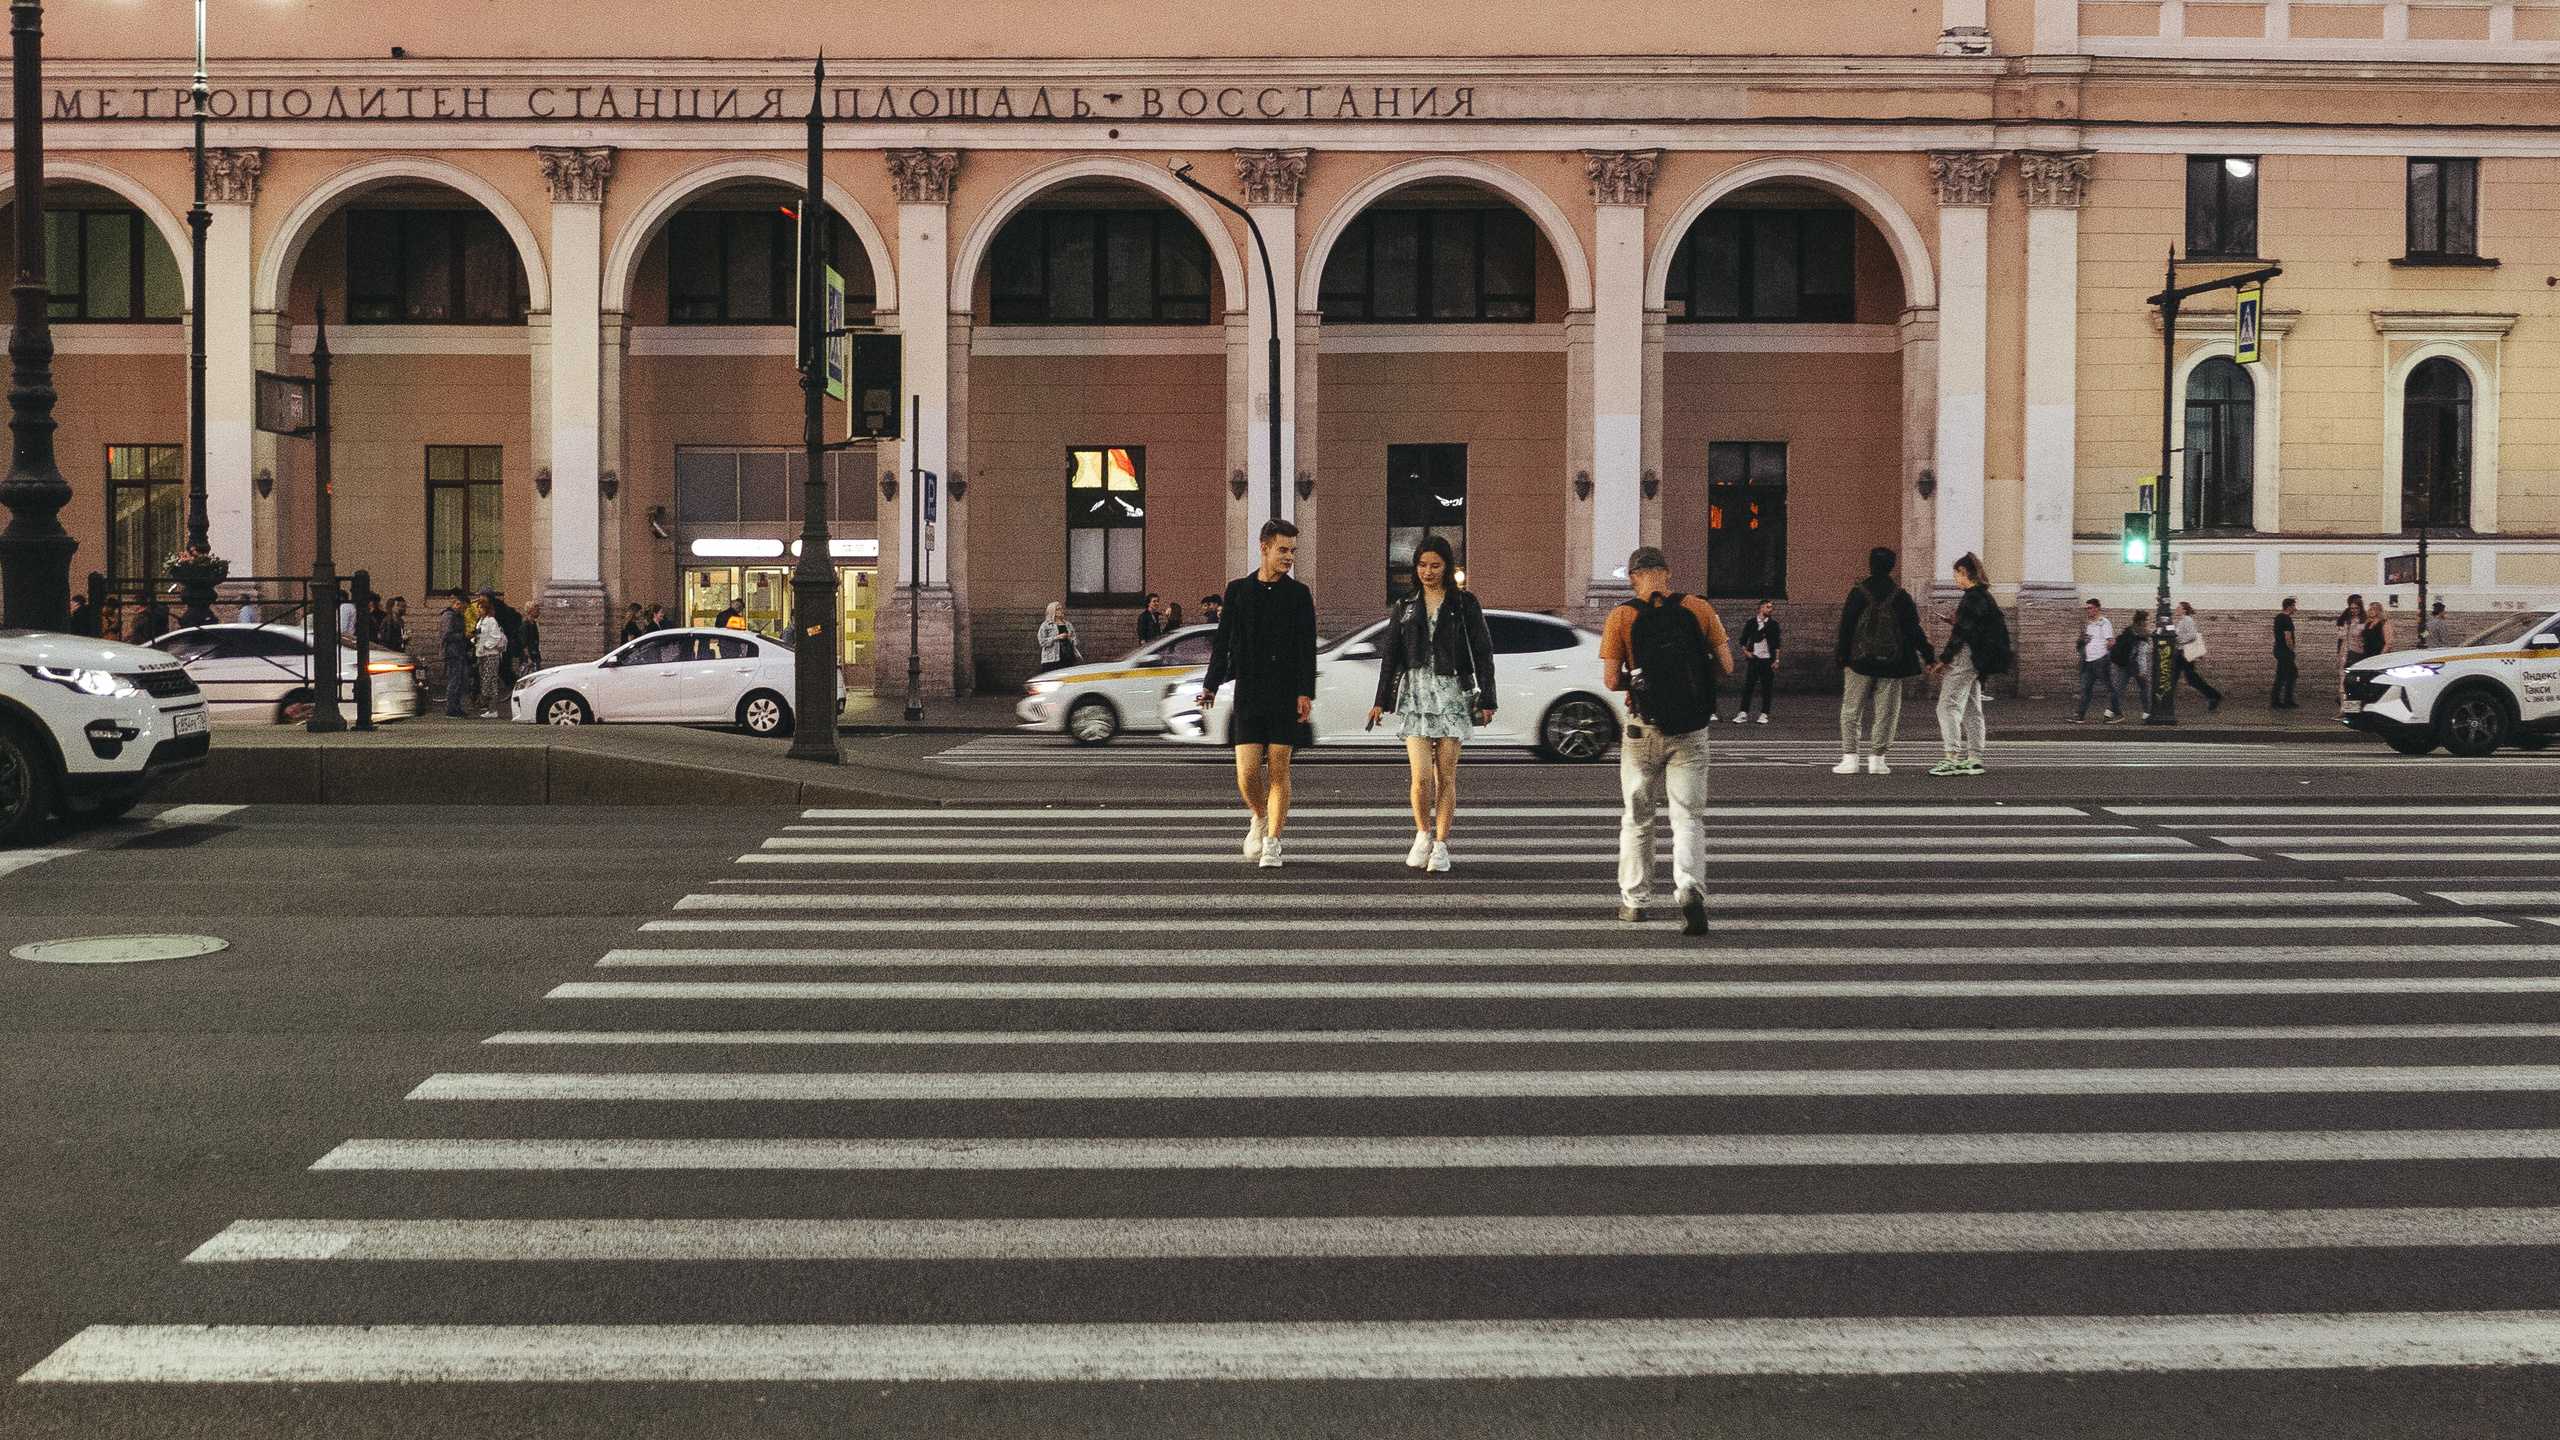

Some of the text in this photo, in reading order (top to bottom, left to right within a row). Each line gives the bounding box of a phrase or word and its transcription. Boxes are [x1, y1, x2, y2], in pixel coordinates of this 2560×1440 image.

[53, 85, 1475, 119] МЕТРОПОЛИТЕН СТАНЦИЯ ПЛОЩАДЬ ВОССТАНИЯ
[2523, 671, 2557, 681] Яндекс
[2524, 685, 2551, 694] Такси
